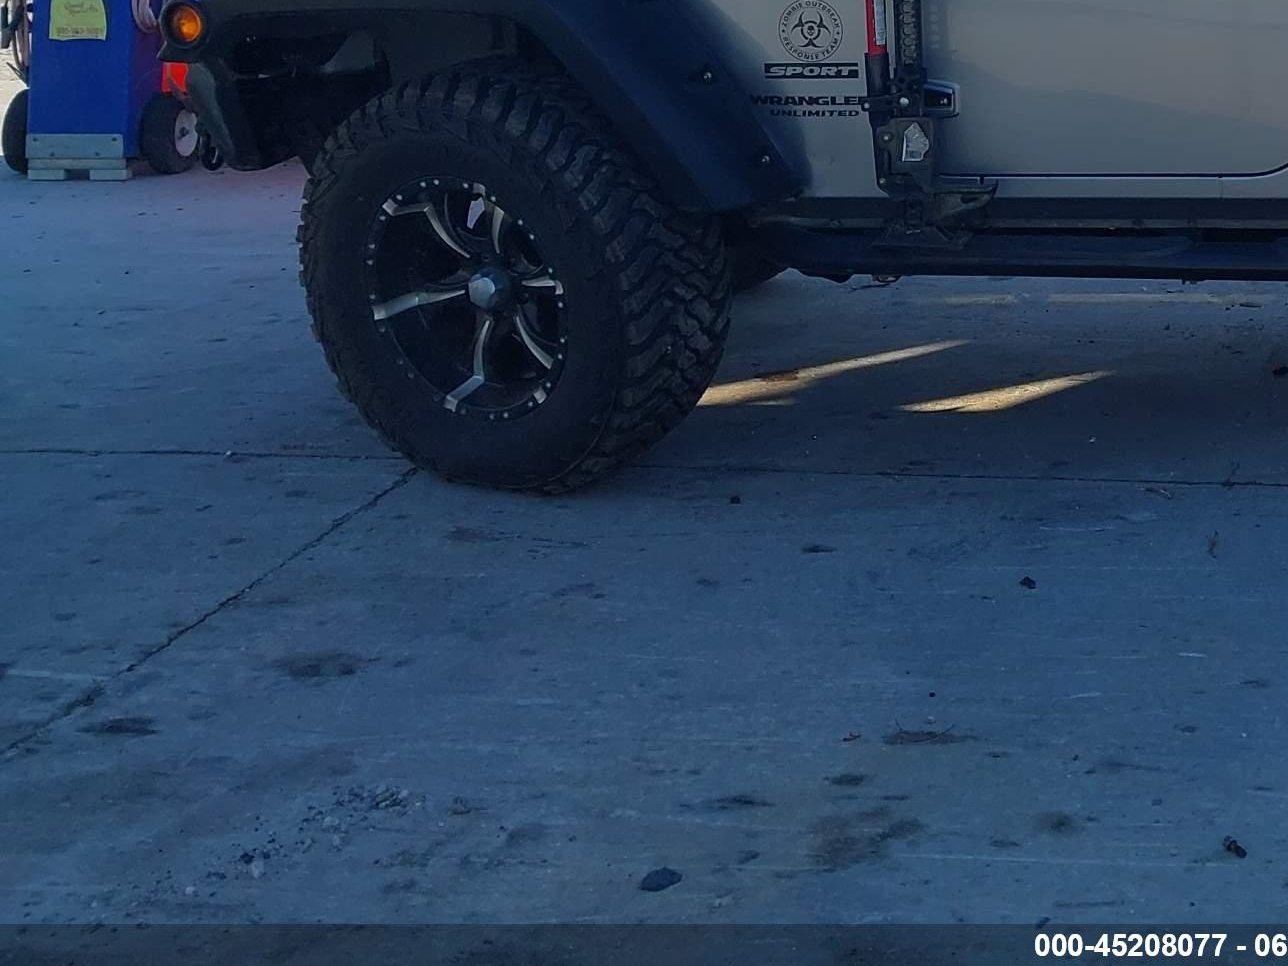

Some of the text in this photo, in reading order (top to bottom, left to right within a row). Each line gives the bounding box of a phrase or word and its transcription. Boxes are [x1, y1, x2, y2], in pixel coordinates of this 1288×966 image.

[781, 0, 841, 28] ZOMBIE OUTBREAK
[783, 36, 838, 61] RESPONSE TEAM
[769, 66, 859, 76] SPORT
[770, 109, 859, 117] UNLIMITED
